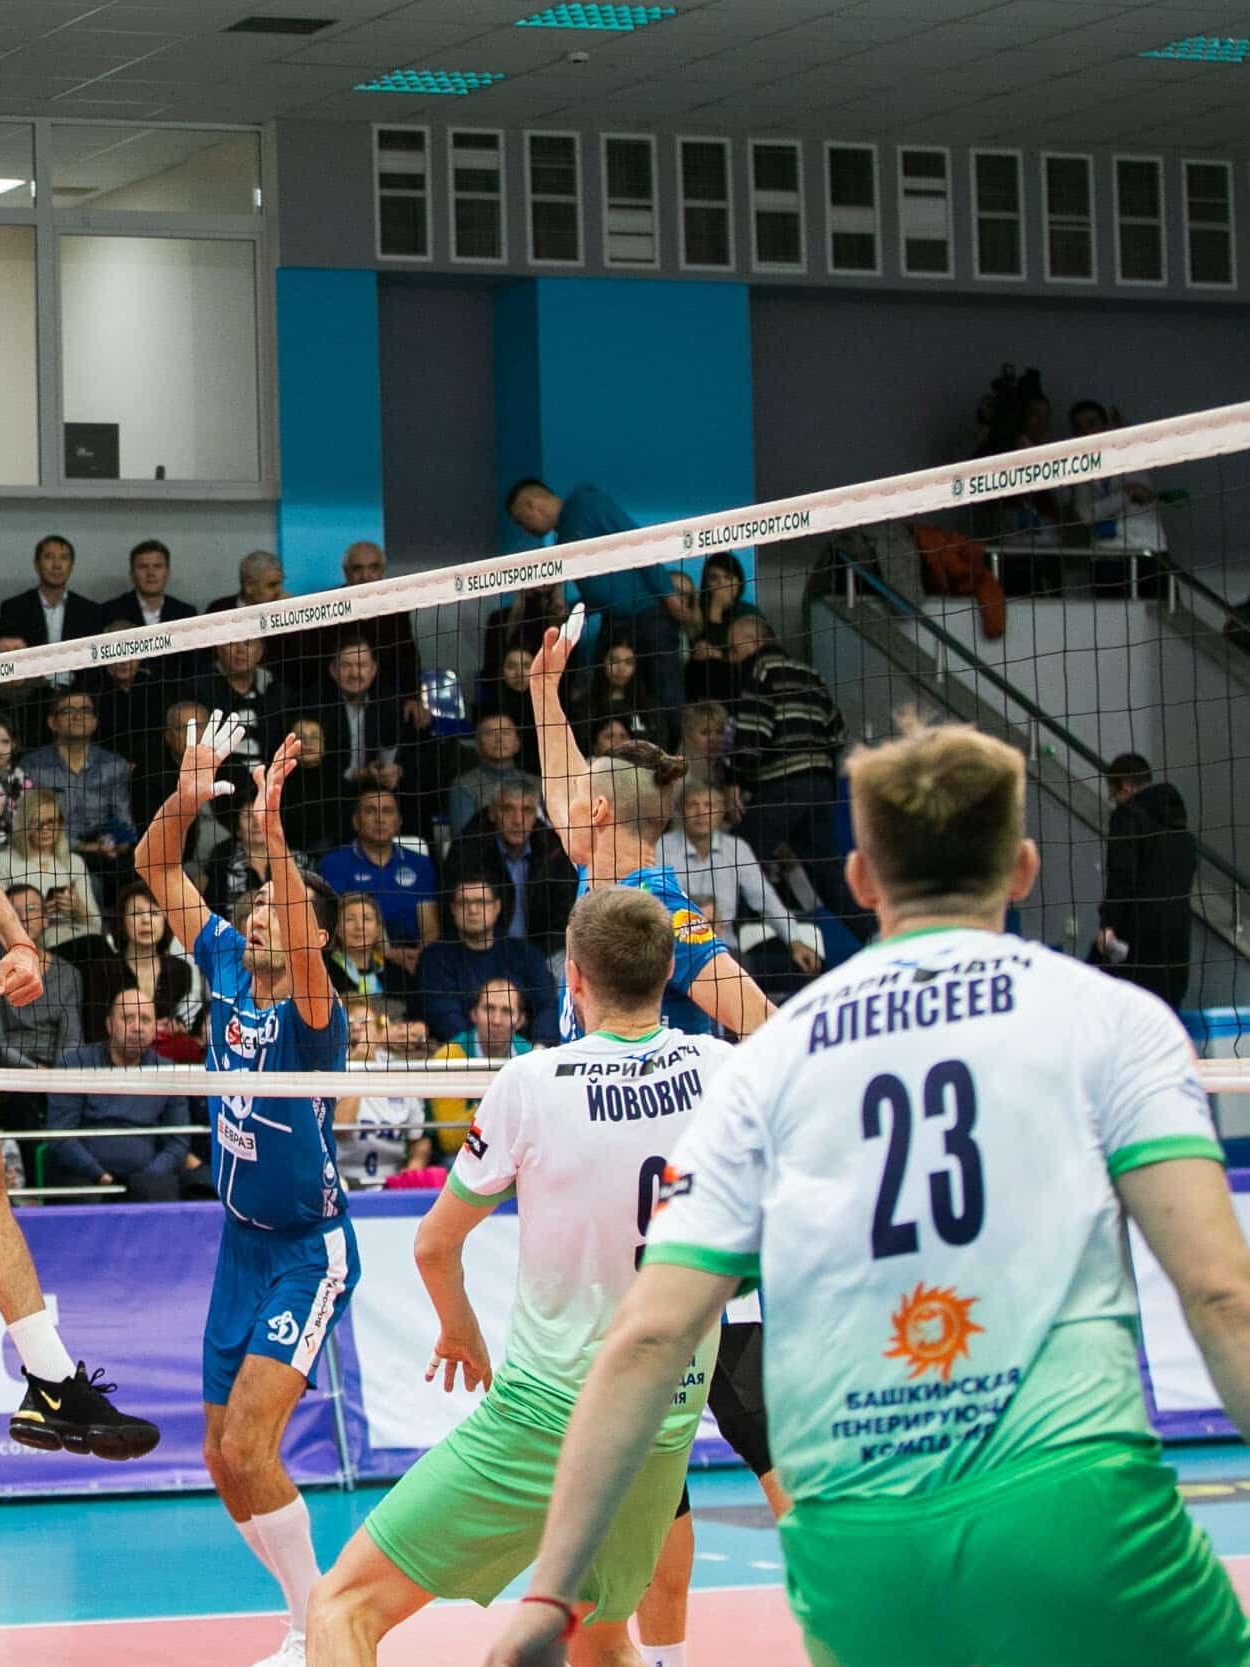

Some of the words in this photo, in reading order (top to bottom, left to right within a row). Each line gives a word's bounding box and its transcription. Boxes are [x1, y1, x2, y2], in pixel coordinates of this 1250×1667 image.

[969, 451, 1103, 495] SELLOUTSPORT.COM
[697, 511, 811, 548] SELLOUTSPORT.COM
[467, 560, 563, 592] SELLOUTSPORT.COM
[270, 600, 352, 629] SELLOUTSPORT.COM
[100, 635, 172, 660] SELLOUTSPORT.COM
[808, 974, 1014, 1055] АЛЕКСЕЕВ
[586, 1068, 703, 1122] ЙОВОВИЧ
[861, 1059, 986, 1261] 23
[845, 1367, 1023, 1411] БАШКИРСКАЯ
